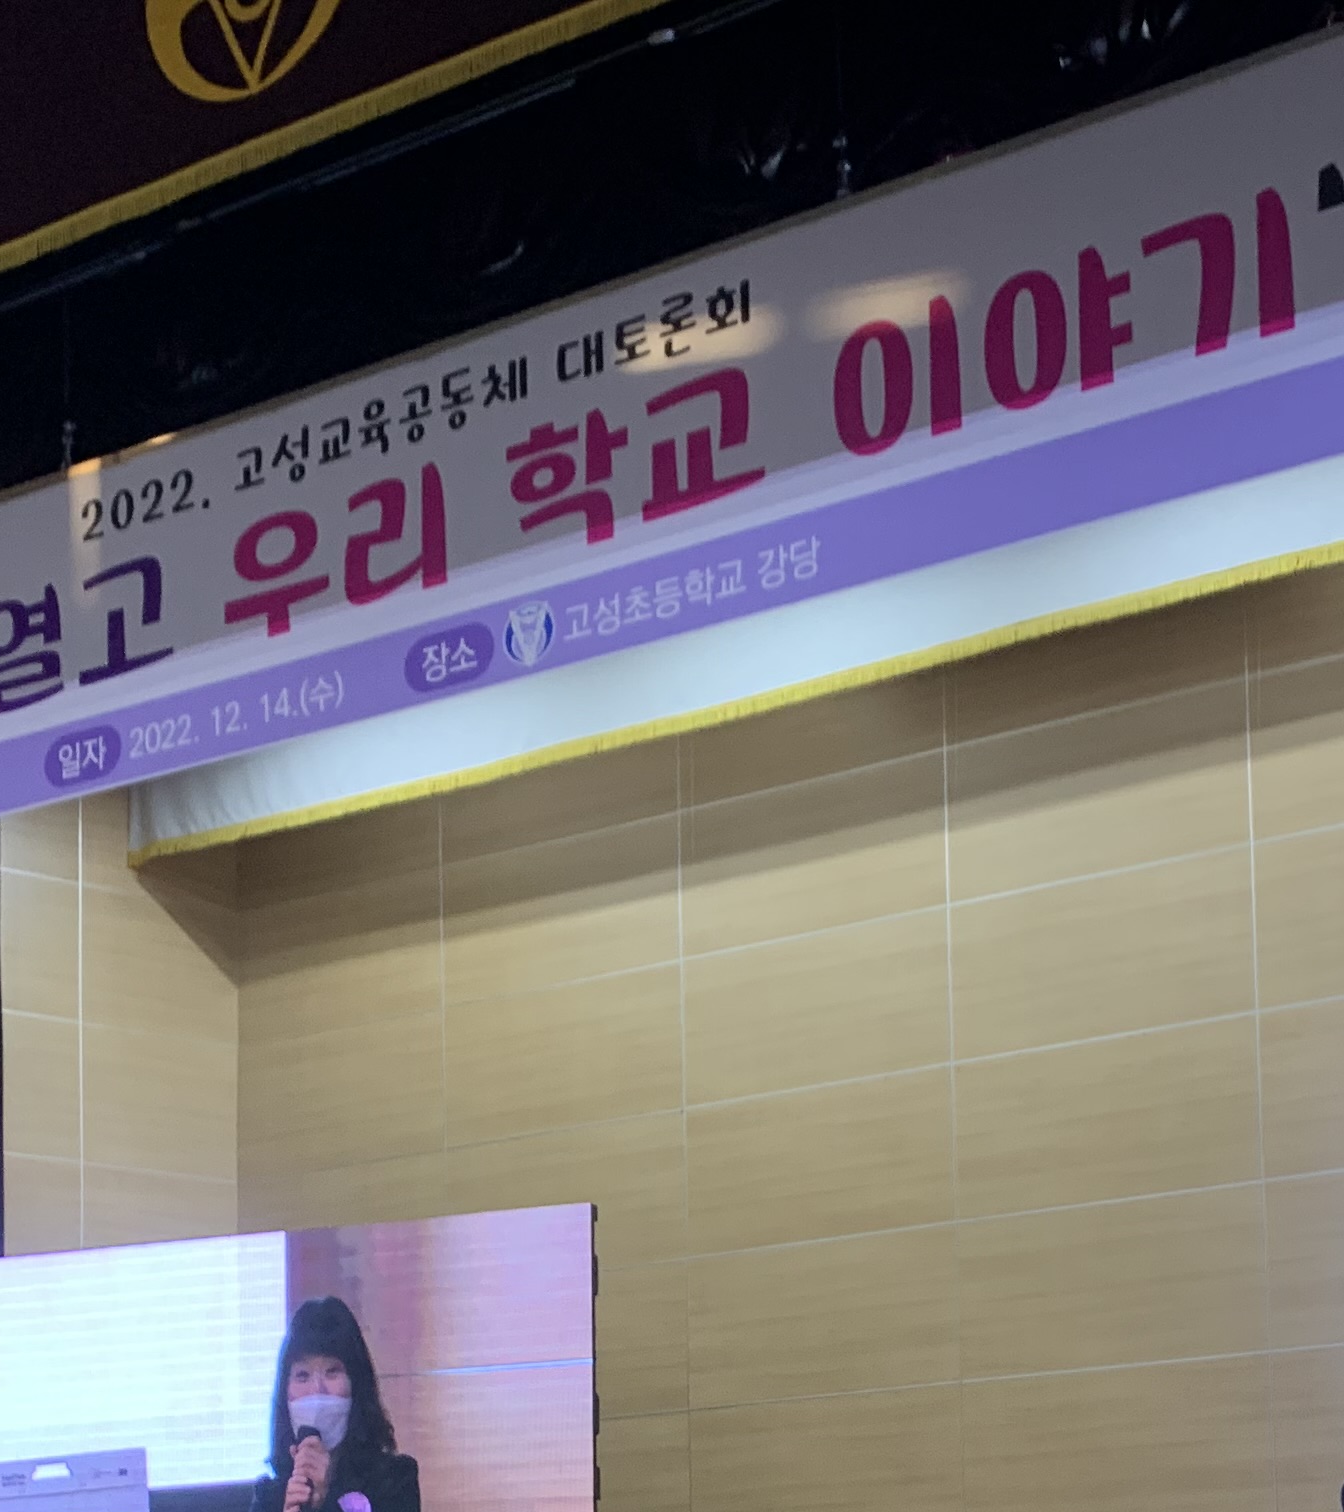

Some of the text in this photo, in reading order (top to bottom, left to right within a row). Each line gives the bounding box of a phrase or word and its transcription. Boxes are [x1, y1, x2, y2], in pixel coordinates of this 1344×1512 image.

[82, 280, 752, 541] 2022. 고성교육공동체 대토론회
[224, 461, 448, 638] 우리
[503, 367, 765, 544] 학교
[563, 536, 821, 643] 고성초등학교 강당
[421, 637, 480, 682] 장소
[58, 736, 109, 776] 일자
[129, 712, 201, 759] 2022.
[212, 700, 248, 734] 12.
